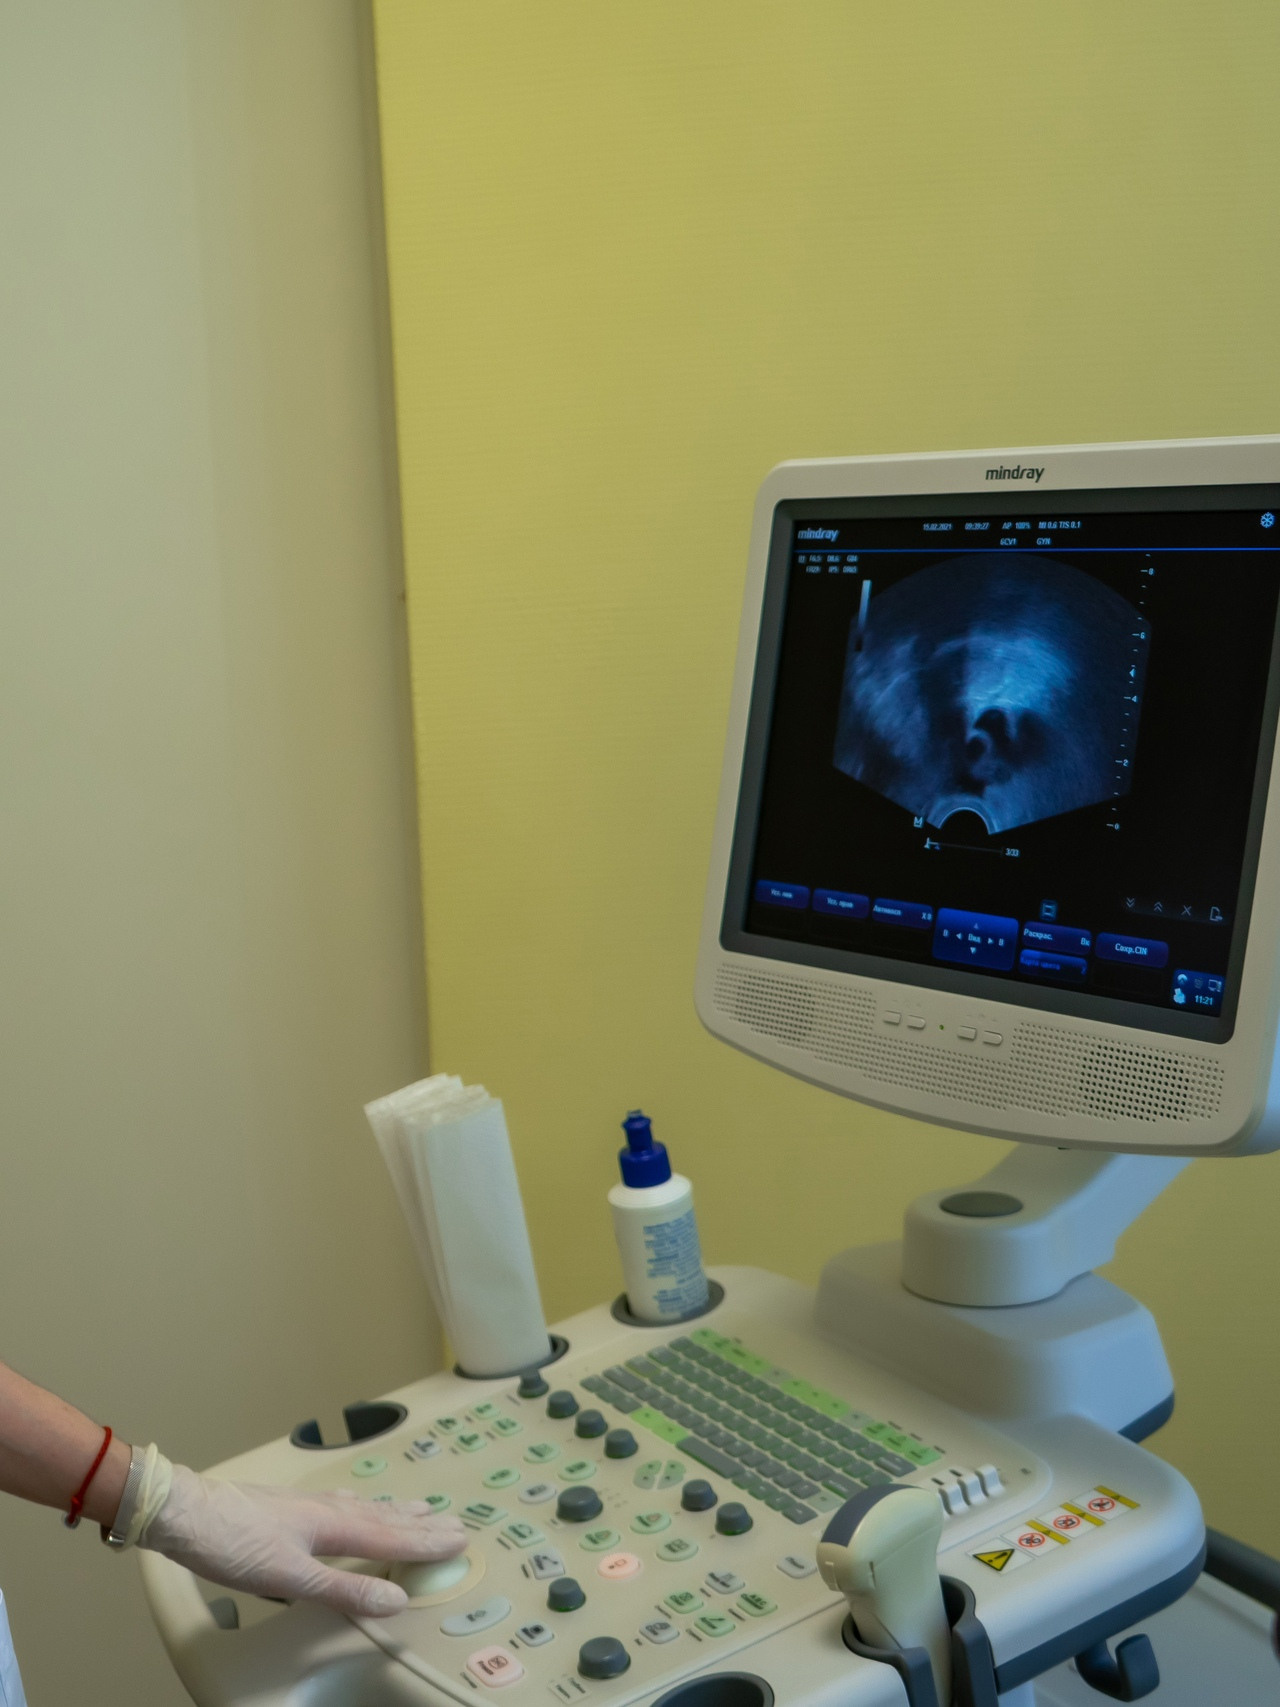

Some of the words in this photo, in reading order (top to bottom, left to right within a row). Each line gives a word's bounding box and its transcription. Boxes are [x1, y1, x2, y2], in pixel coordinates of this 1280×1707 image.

[985, 465, 1045, 483] mindray
[1059, 520, 1070, 529] TIS
[1070, 520, 1081, 529] 0.1
[798, 527, 839, 542] mindray
[1036, 537, 1051, 545] GYN
[1194, 994, 1213, 1005] 11:21
